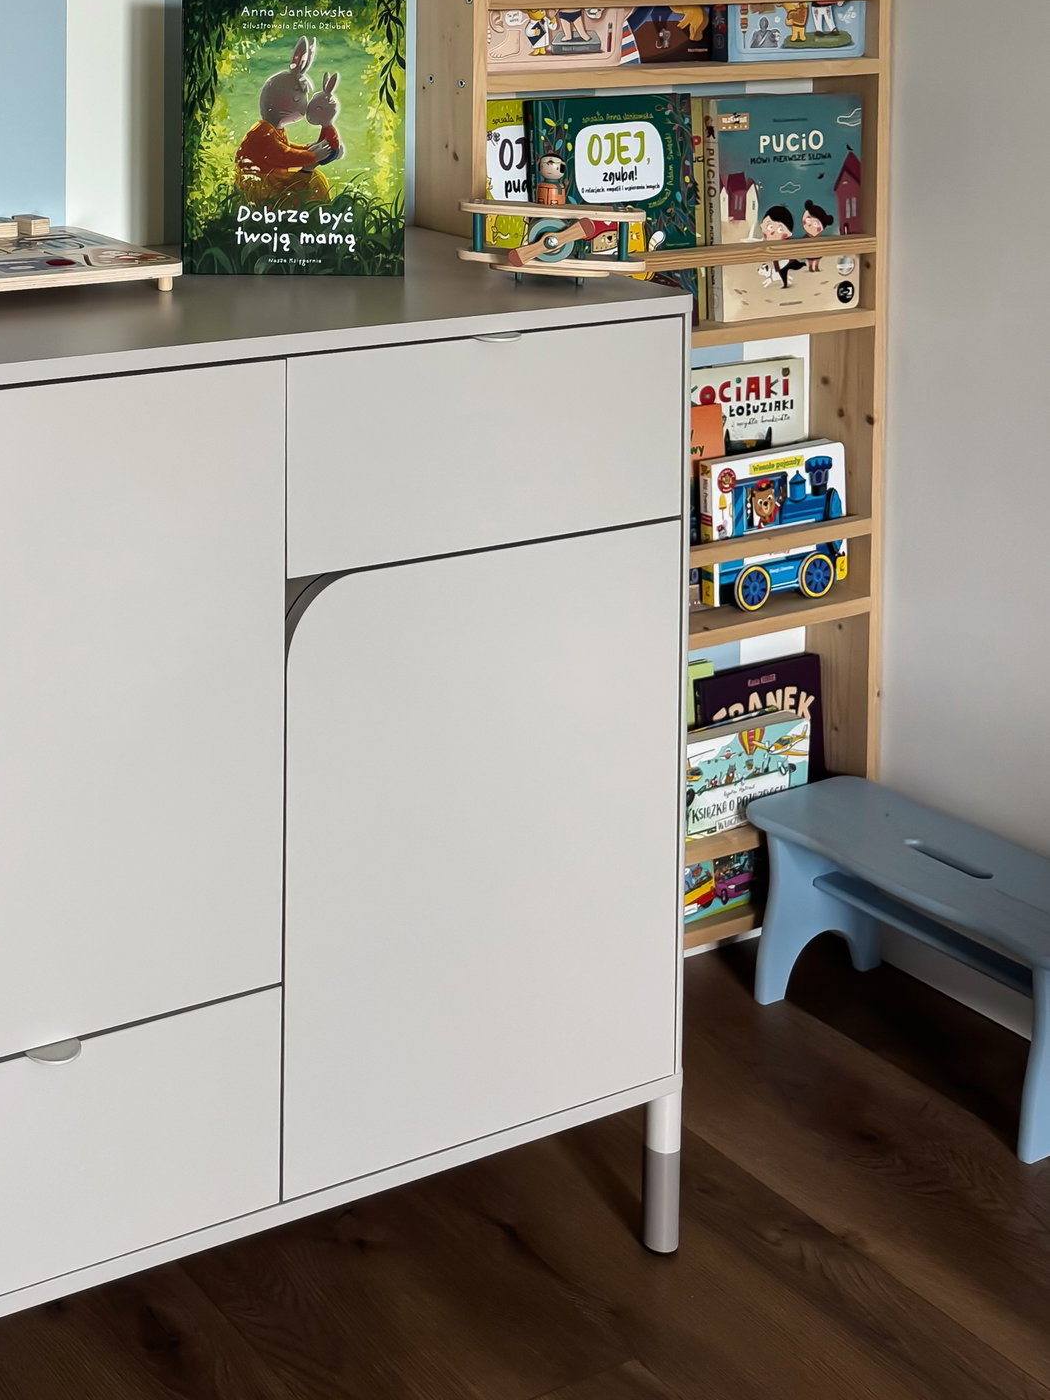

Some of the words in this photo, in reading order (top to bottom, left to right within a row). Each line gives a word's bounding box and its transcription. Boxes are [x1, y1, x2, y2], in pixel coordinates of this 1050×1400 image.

[240, 6, 274, 17] Anna
[280, 6, 353, 18] Jankowska
[292, 21, 317, 30] Emilia
[319, 22, 351, 30] Dziubak
[606, 113, 622, 122] Anna
[587, 130, 651, 166] OJEJ,
[808, 152, 832, 161] SŁOWA
[602, 166, 638, 186] zguba!
[236, 205, 310, 224] Dobrze
[318, 206, 354, 230] być
[235, 226, 291, 252] twoją
[300, 231, 356, 252] mamą
[729, 399, 794, 417] ŁOBUZIAKI
[729, 799, 735, 811] O
